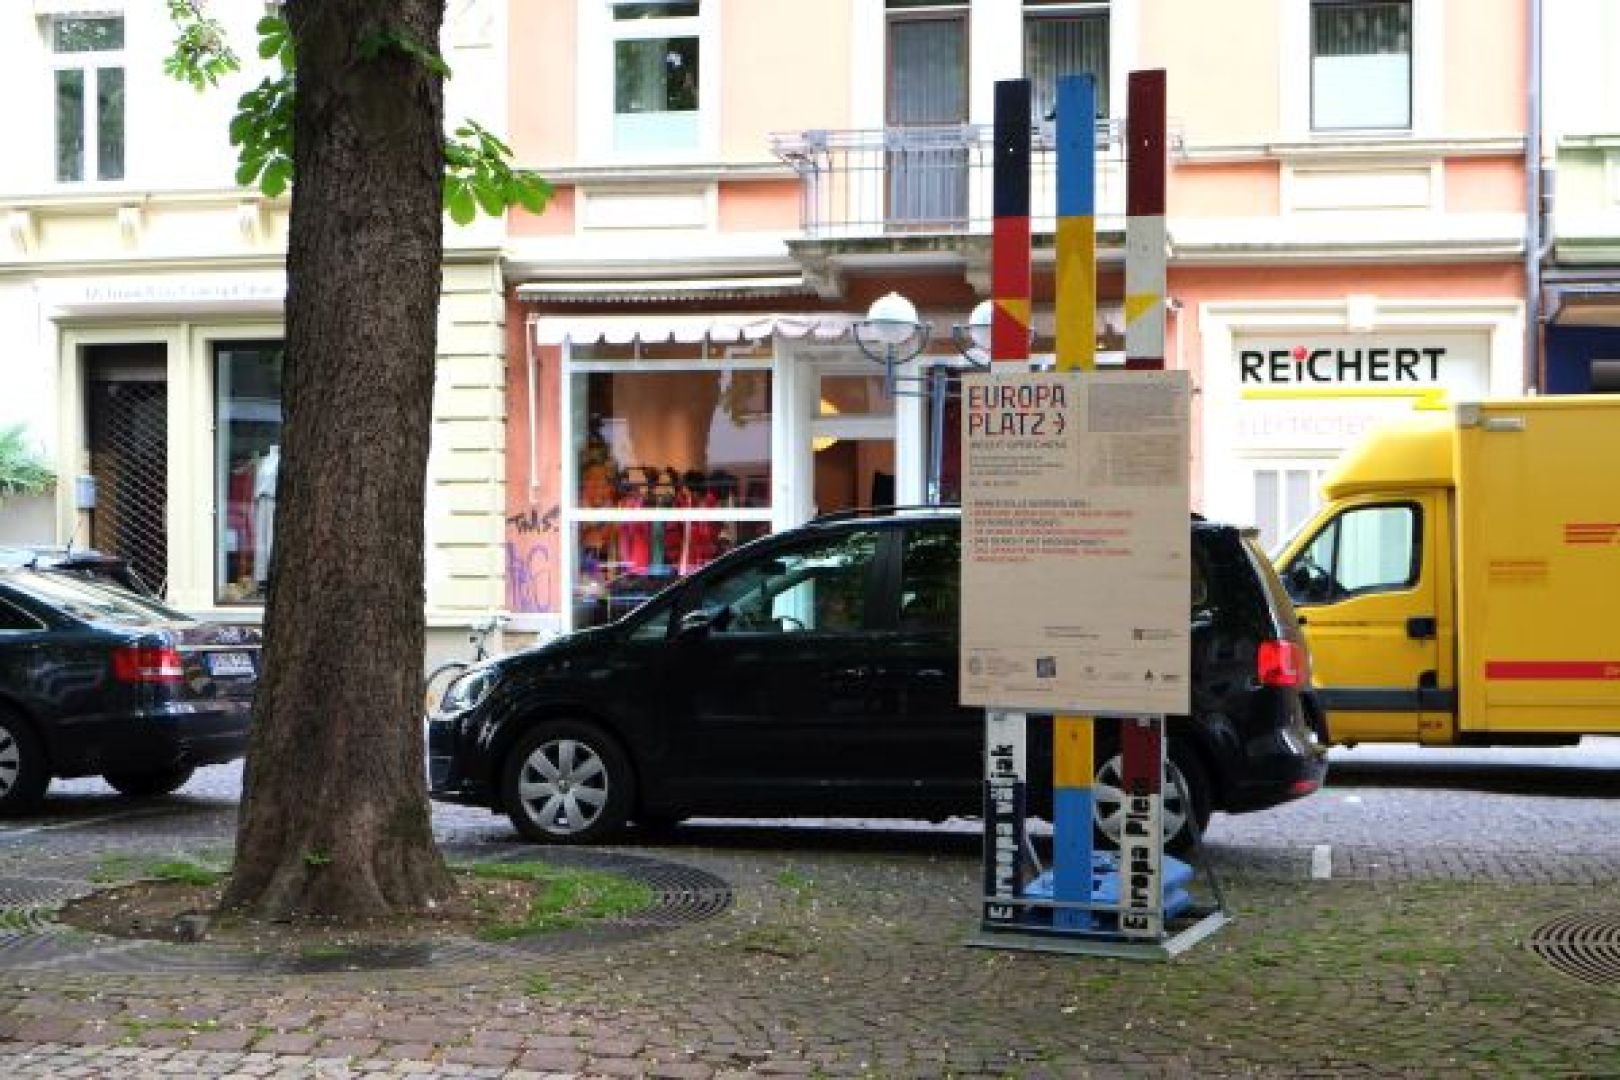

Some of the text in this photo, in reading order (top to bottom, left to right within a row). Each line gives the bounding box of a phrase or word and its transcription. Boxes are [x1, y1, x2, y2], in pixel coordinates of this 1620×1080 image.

[1240, 345, 1448, 383] REiCHERT
[968, 385, 1066, 408] EUROPA
[968, 412, 1046, 436] PLATZ
